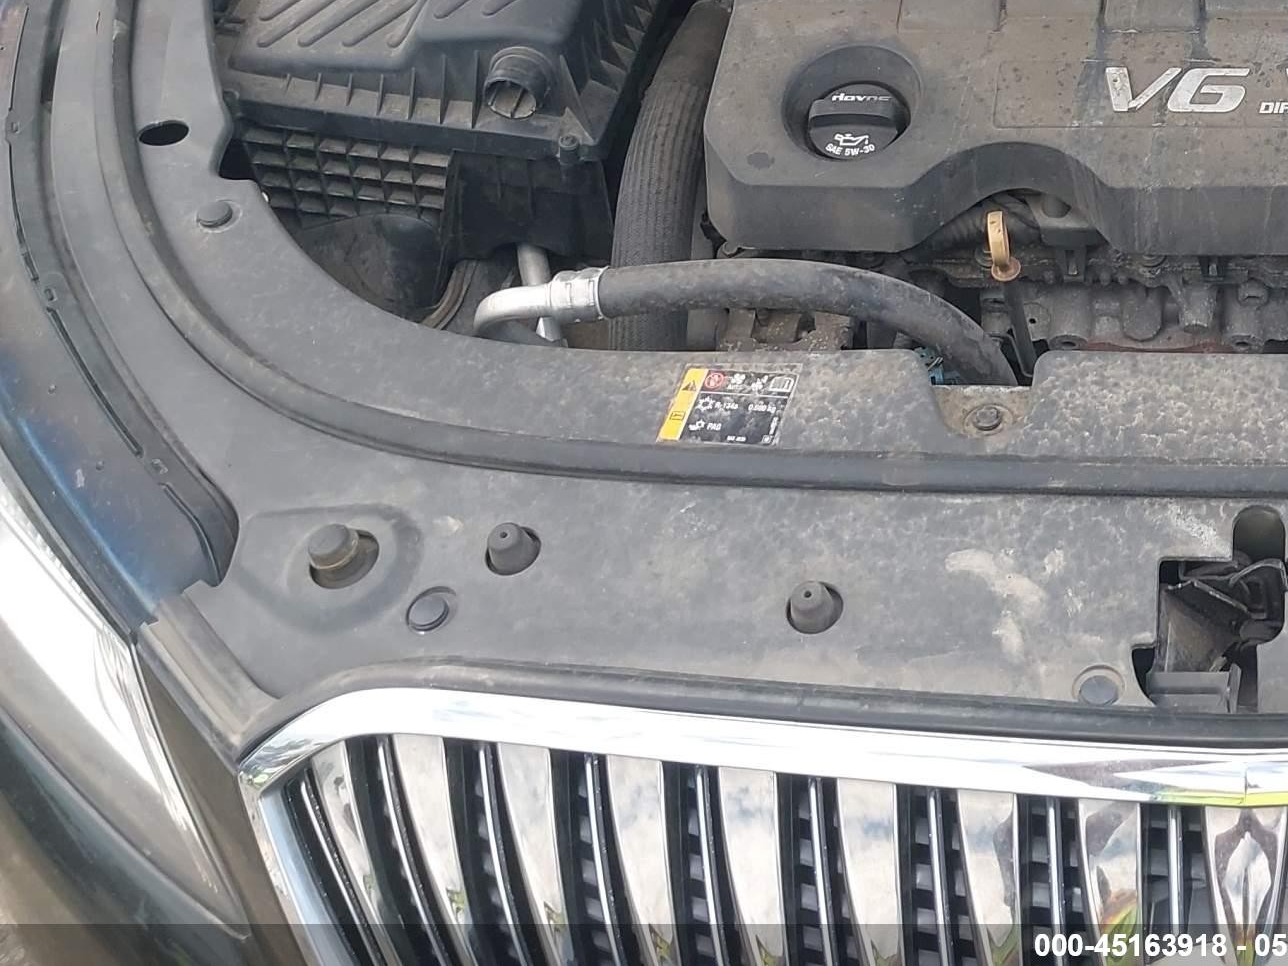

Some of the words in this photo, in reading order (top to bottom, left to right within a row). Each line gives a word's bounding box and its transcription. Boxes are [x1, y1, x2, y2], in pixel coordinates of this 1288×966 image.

[1105, 67, 1251, 113] V6
[825, 143, 843, 156] SAE
[844, 143, 875, 156] 5W-30
